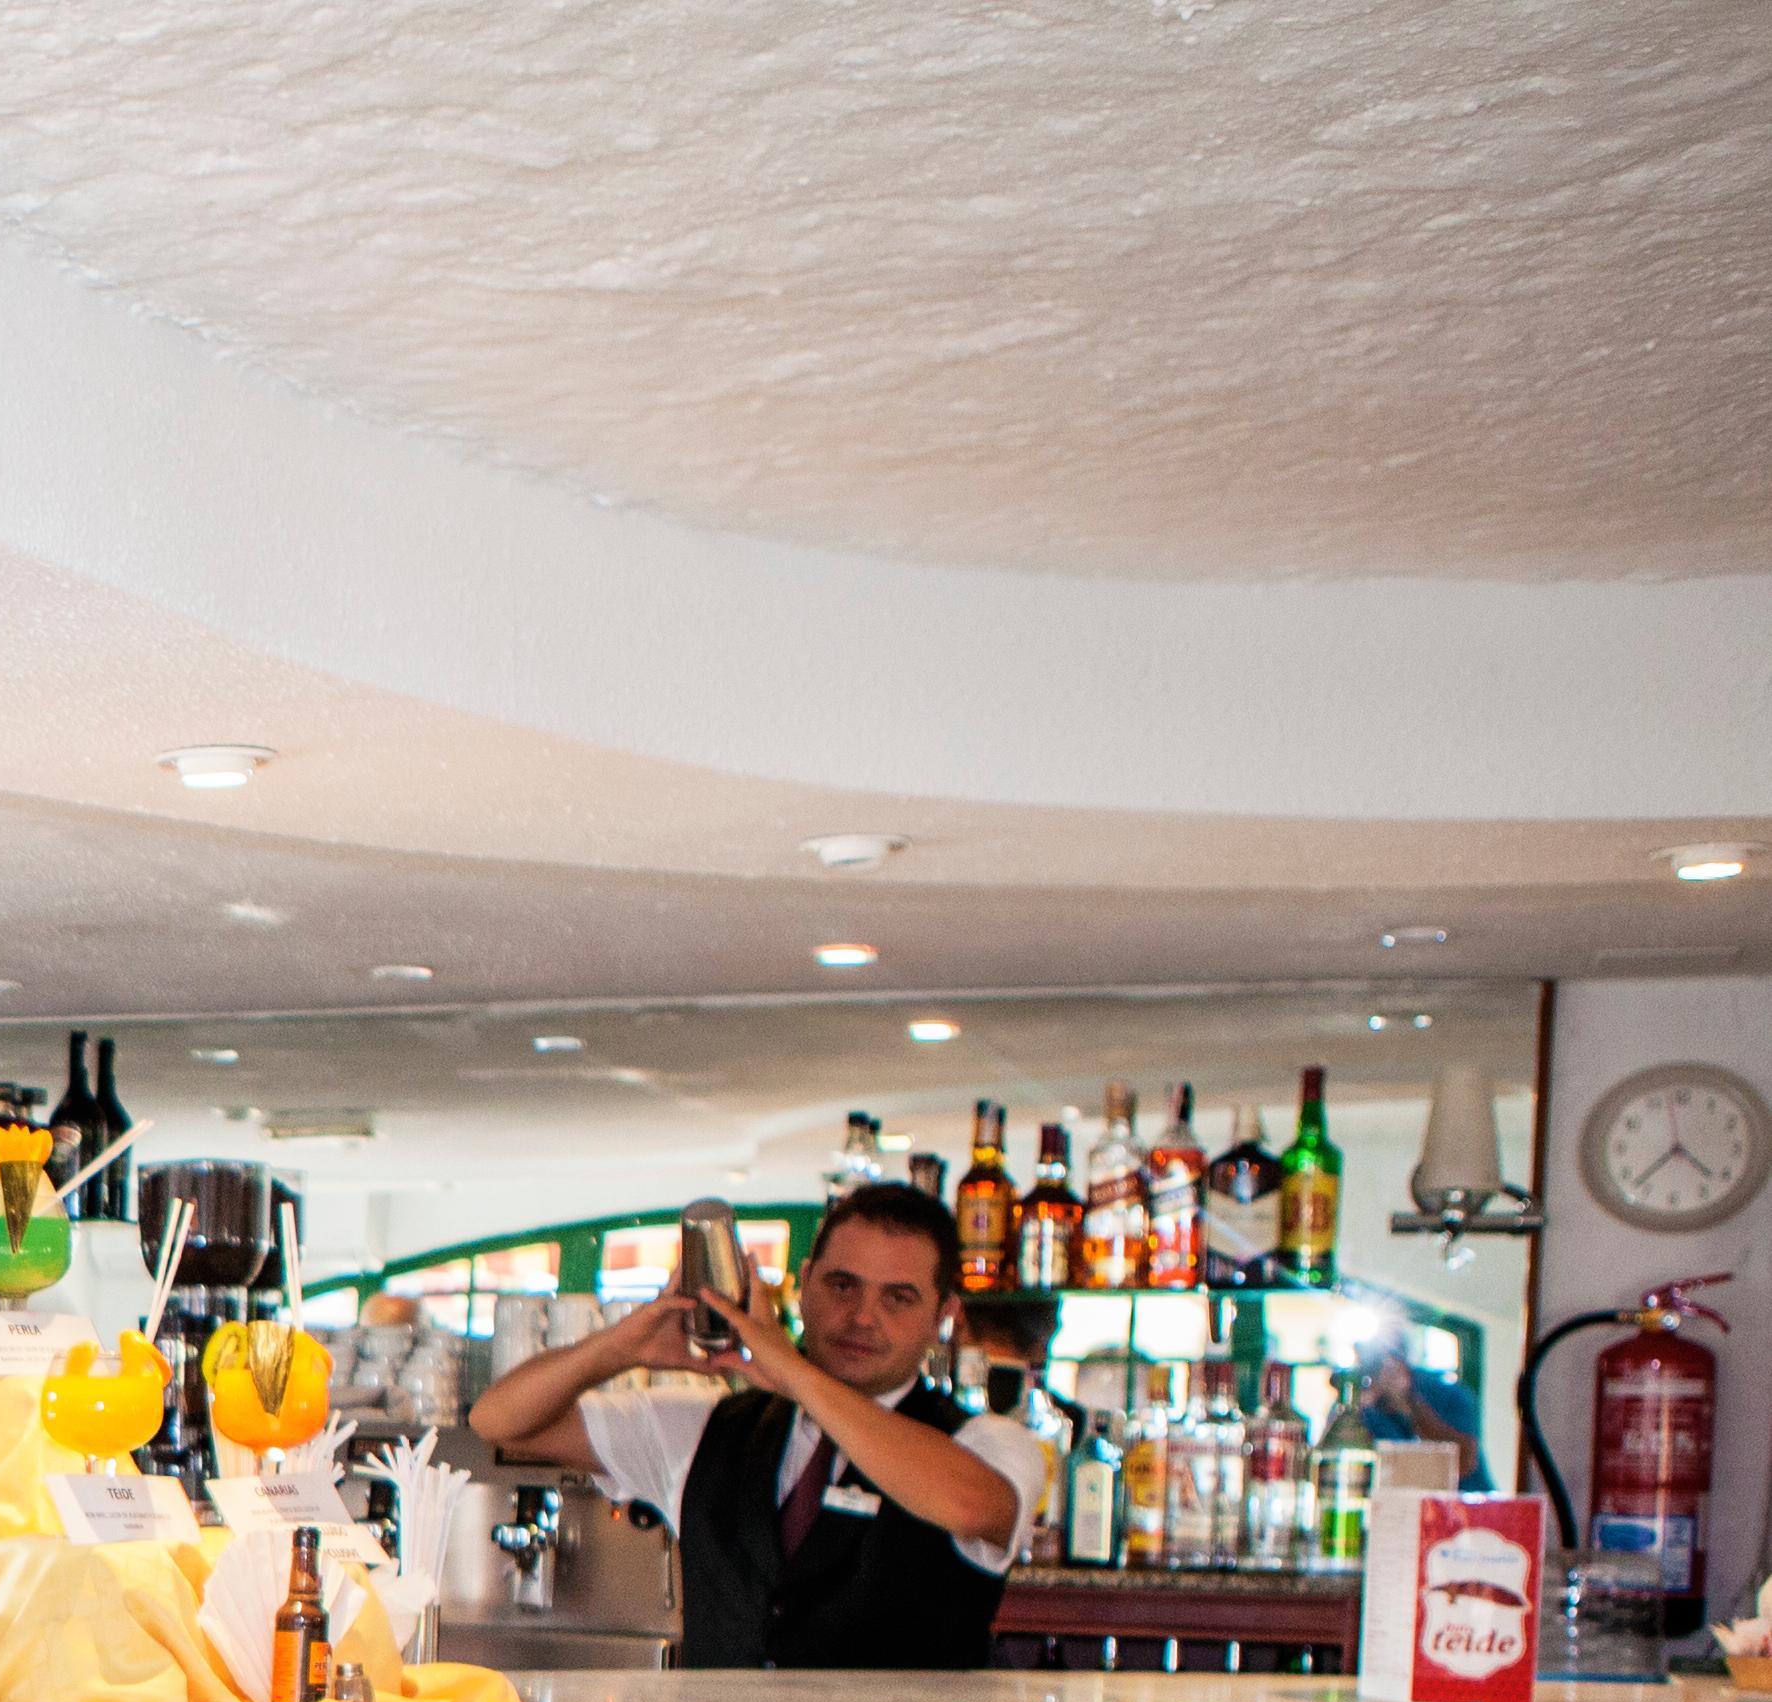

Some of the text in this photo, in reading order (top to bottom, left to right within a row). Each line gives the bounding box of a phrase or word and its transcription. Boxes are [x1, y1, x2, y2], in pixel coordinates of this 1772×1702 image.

[8, 1323, 42, 1336] PERLA
[106, 1487, 136, 1501] TEIDE
[254, 1484, 300, 1497] CANARIAS
[1432, 1629, 1516, 1655] teide
